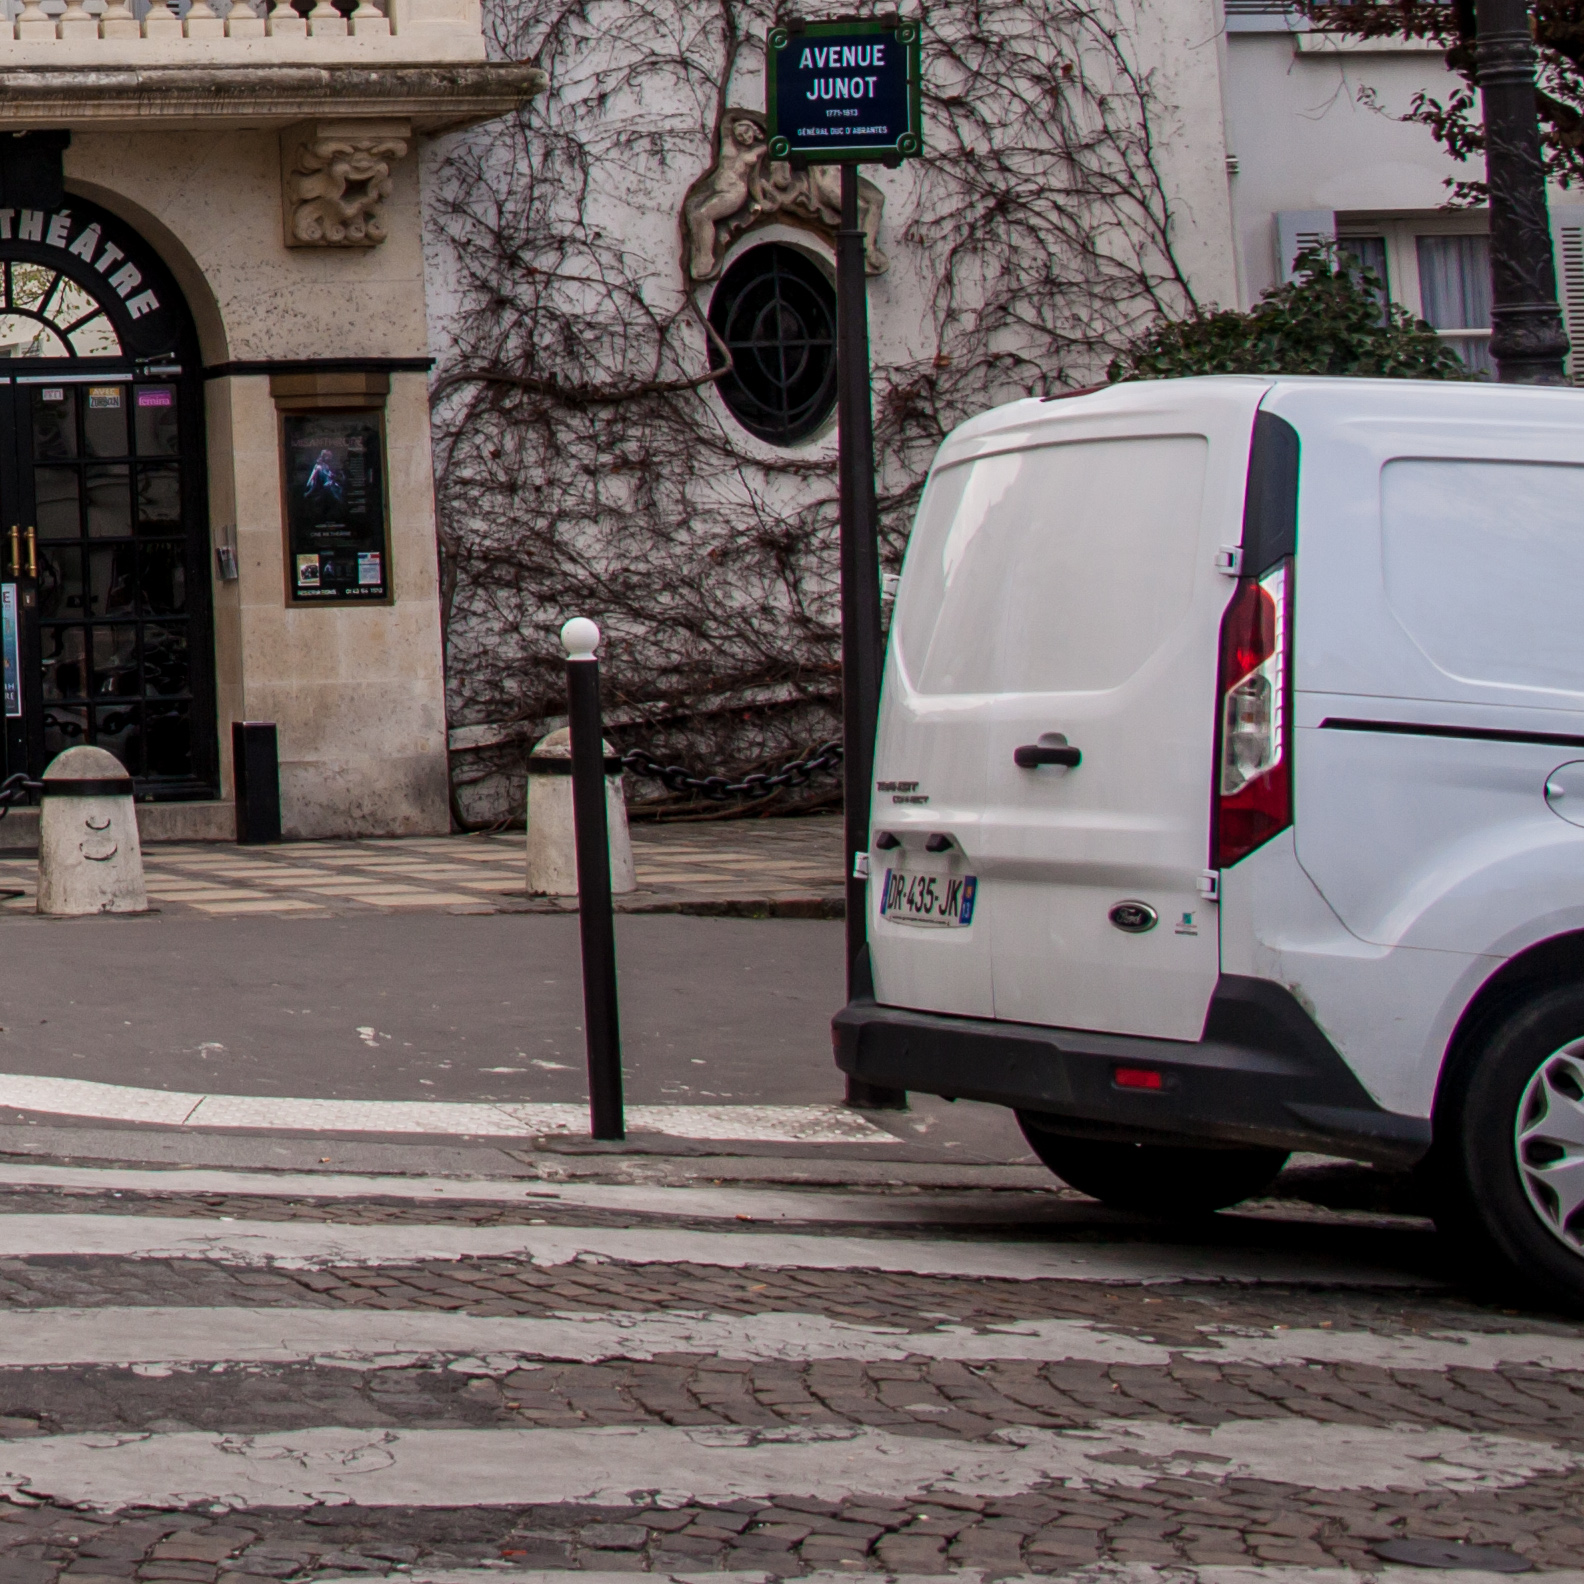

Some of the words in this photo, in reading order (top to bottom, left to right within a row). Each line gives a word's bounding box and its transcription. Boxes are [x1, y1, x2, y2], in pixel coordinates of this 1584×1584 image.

[798, 44, 886, 69] AVENUE
[806, 76, 878, 101] JUNOT
[825, 108, 859, 117] 1771-1813
[887, 873, 963, 917] DR-435-JK
